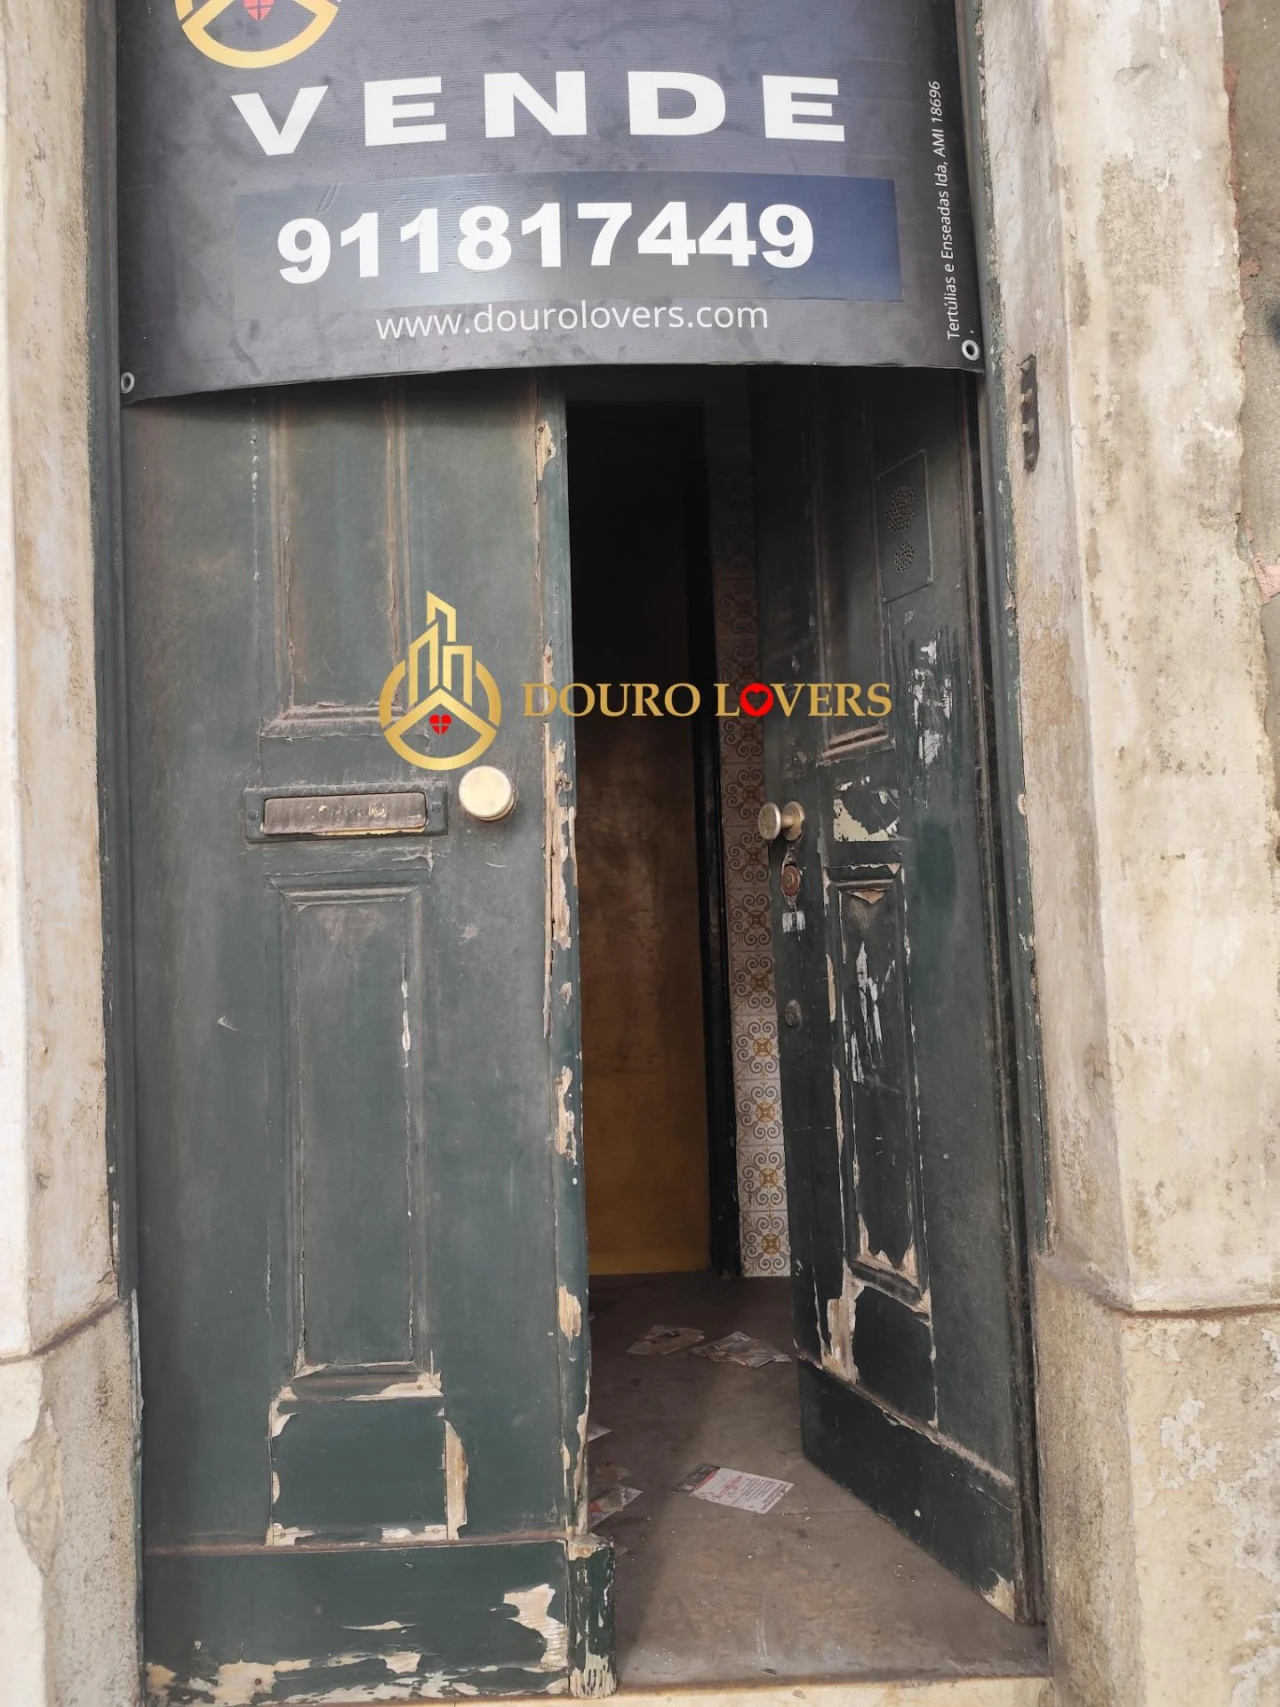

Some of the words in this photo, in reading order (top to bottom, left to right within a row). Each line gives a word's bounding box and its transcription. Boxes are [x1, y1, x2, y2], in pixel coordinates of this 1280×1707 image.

[231, 71, 845, 156] VENDE
[928, 80, 943, 123] 18696
[931, 128, 946, 158] AMI
[277, 202, 814, 284] 911817449
[937, 190, 954, 260] Enseadas
[944, 263, 955, 273] e
[375, 300, 768, 340] www.dourolovers.com
[943, 276, 960, 340] Tertúlias
